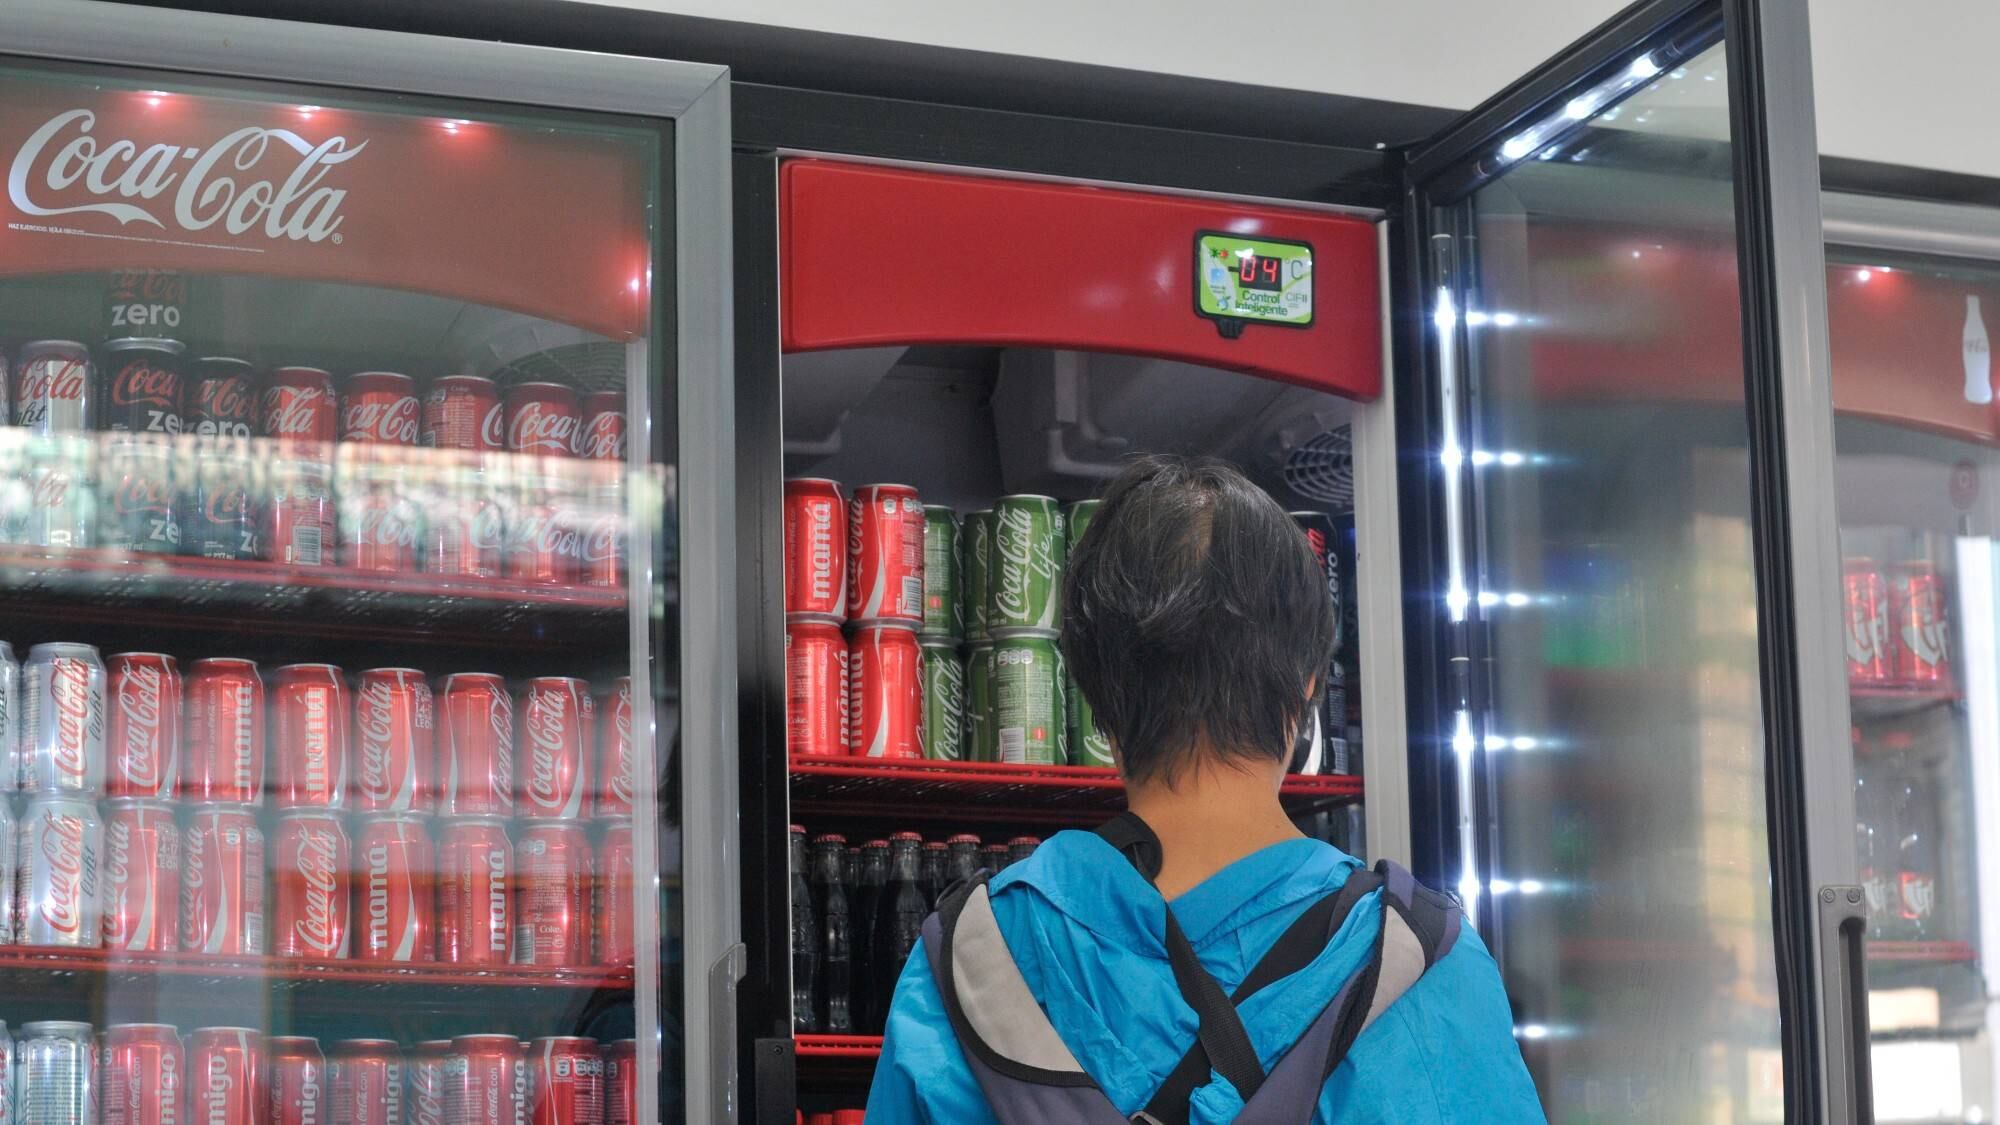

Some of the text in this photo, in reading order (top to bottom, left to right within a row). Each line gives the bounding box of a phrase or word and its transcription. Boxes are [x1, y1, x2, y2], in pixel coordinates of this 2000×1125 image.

[8, 108, 369, 242] Coca-Cola
[111, 303, 181, 328] zero
[1240, 255, 1278, 282] 04
[1242, 290, 1281, 305] Control
[804, 502, 831, 599] mamá
[995, 504, 1032, 620] Coca-Cola
[51, 653, 89, 777] Coca-Cola
[88, 690, 104, 742] light
[118, 658, 160, 787] Coca-Cola
[226, 686, 252, 788] mamá
[296, 687, 325, 791] mamá
[358, 680, 392, 801] Coca-Cola
[526, 685, 564, 808] Coca-Cola
[40, 809, 81, 933] Coca-Cola
[80, 847, 97, 898] light
[296, 822, 337, 951] Coca-Cola
[361, 845, 388, 949] mamá
[480, 849, 505, 951] mamá
[154, 1053, 179, 1125] migo
[203, 1055, 233, 1125] migo
